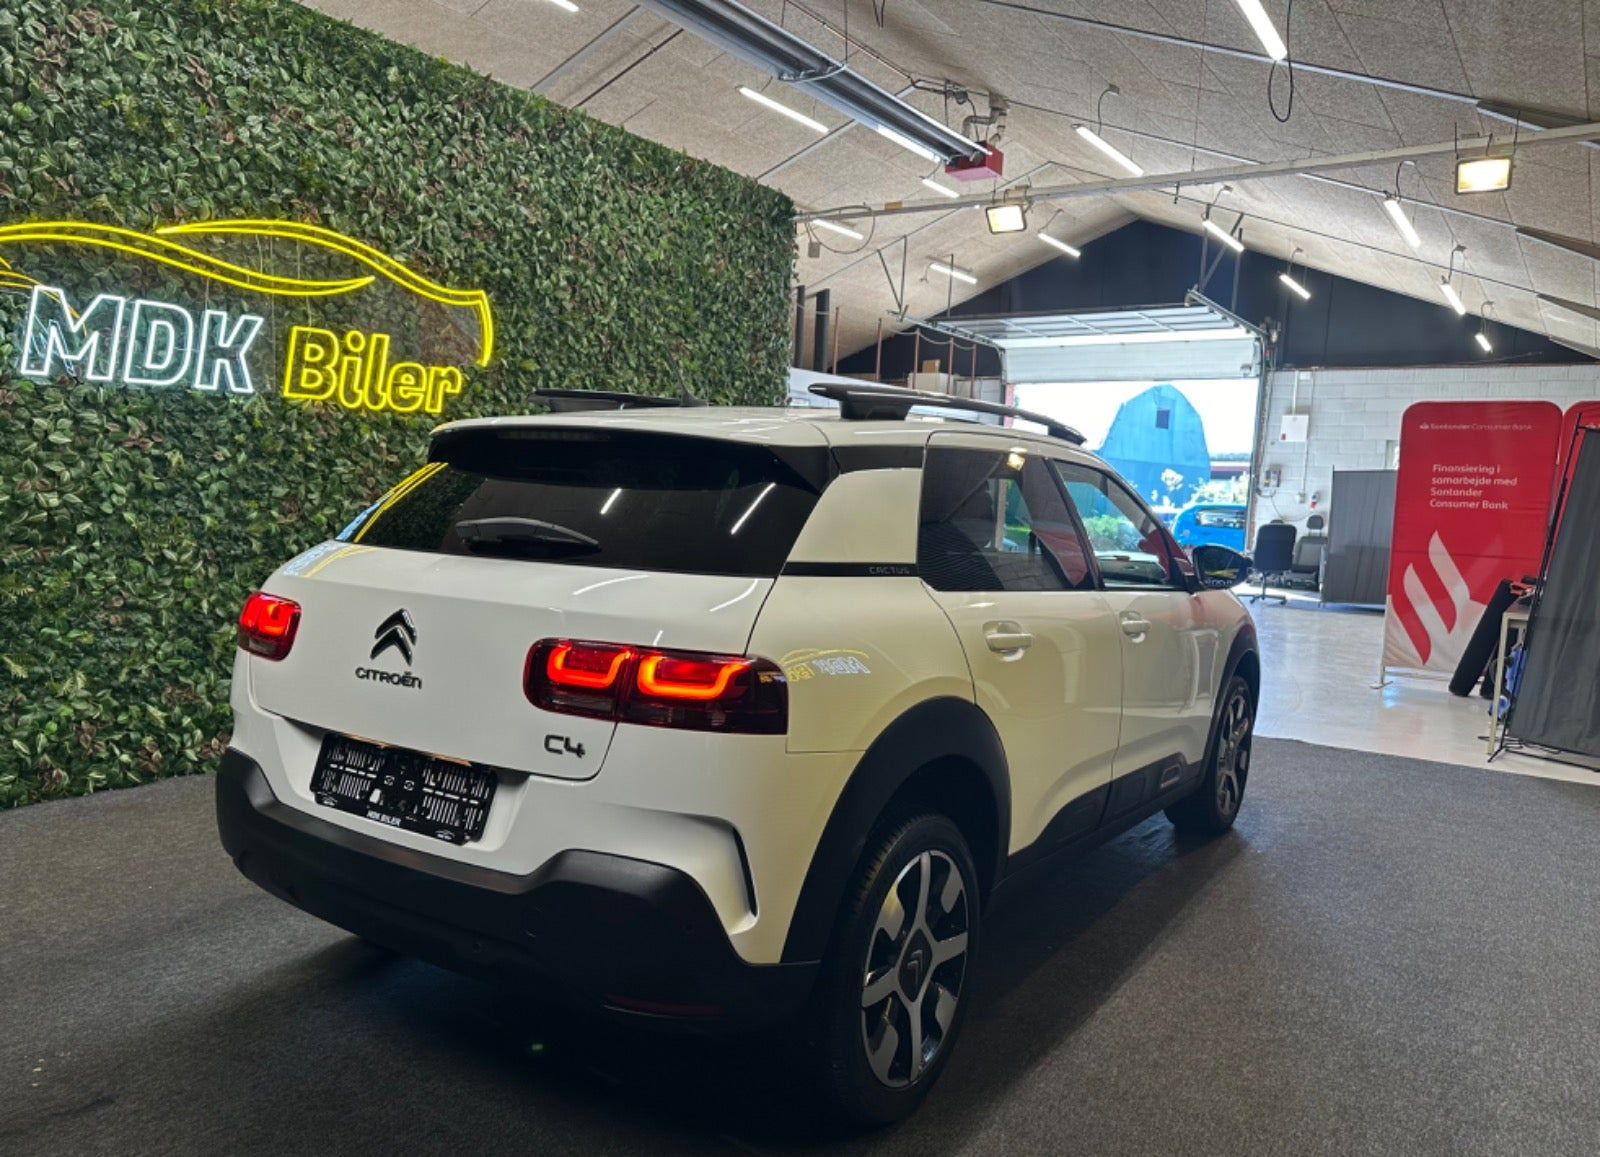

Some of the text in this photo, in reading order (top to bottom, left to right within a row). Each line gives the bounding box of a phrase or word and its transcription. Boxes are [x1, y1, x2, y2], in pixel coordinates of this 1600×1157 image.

[20, 284, 464, 414] MDK Biler
[1432, 464, 1495, 475] Finansiering
[1432, 476, 1518, 487] samarbejde med
[1430, 487, 1483, 497] Santander
[1429, 498, 1509, 510] Consumer Bank
[869, 566, 910, 575] CACTUS
[544, 734, 586, 759] C4
